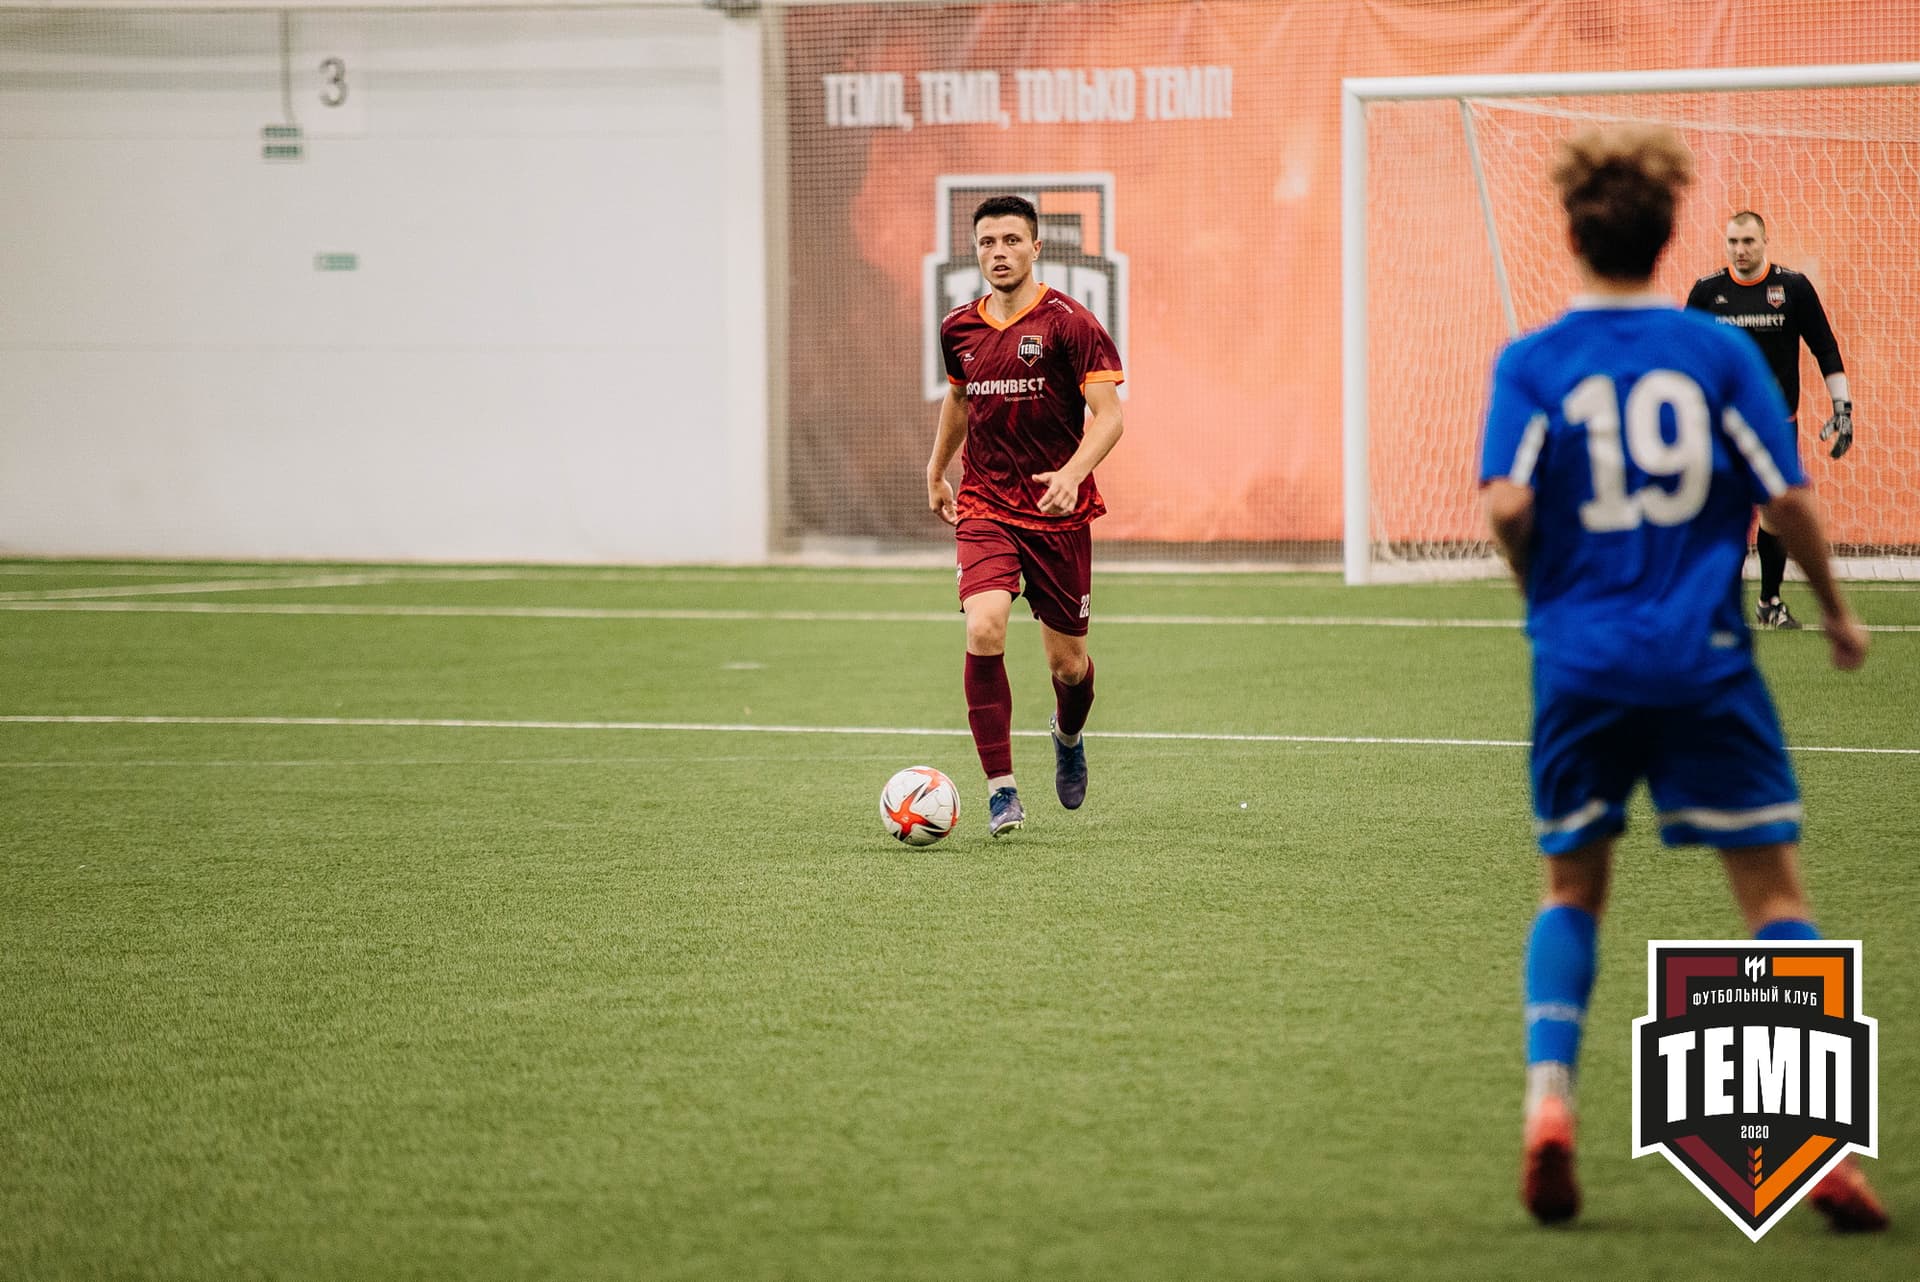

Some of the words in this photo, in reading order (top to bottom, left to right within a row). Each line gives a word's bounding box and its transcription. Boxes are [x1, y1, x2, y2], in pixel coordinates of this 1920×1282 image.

[318, 57, 348, 108] 3
[823, 72, 914, 132] ТЕМП,
[918, 70, 1011, 130] ТЕМП,
[1015, 68, 1136, 123] ТОЛЬКО
[1144, 66, 1233, 120] ТЕМП!
[1562, 368, 1713, 533] 19
[1079, 594, 1091, 619] 22
